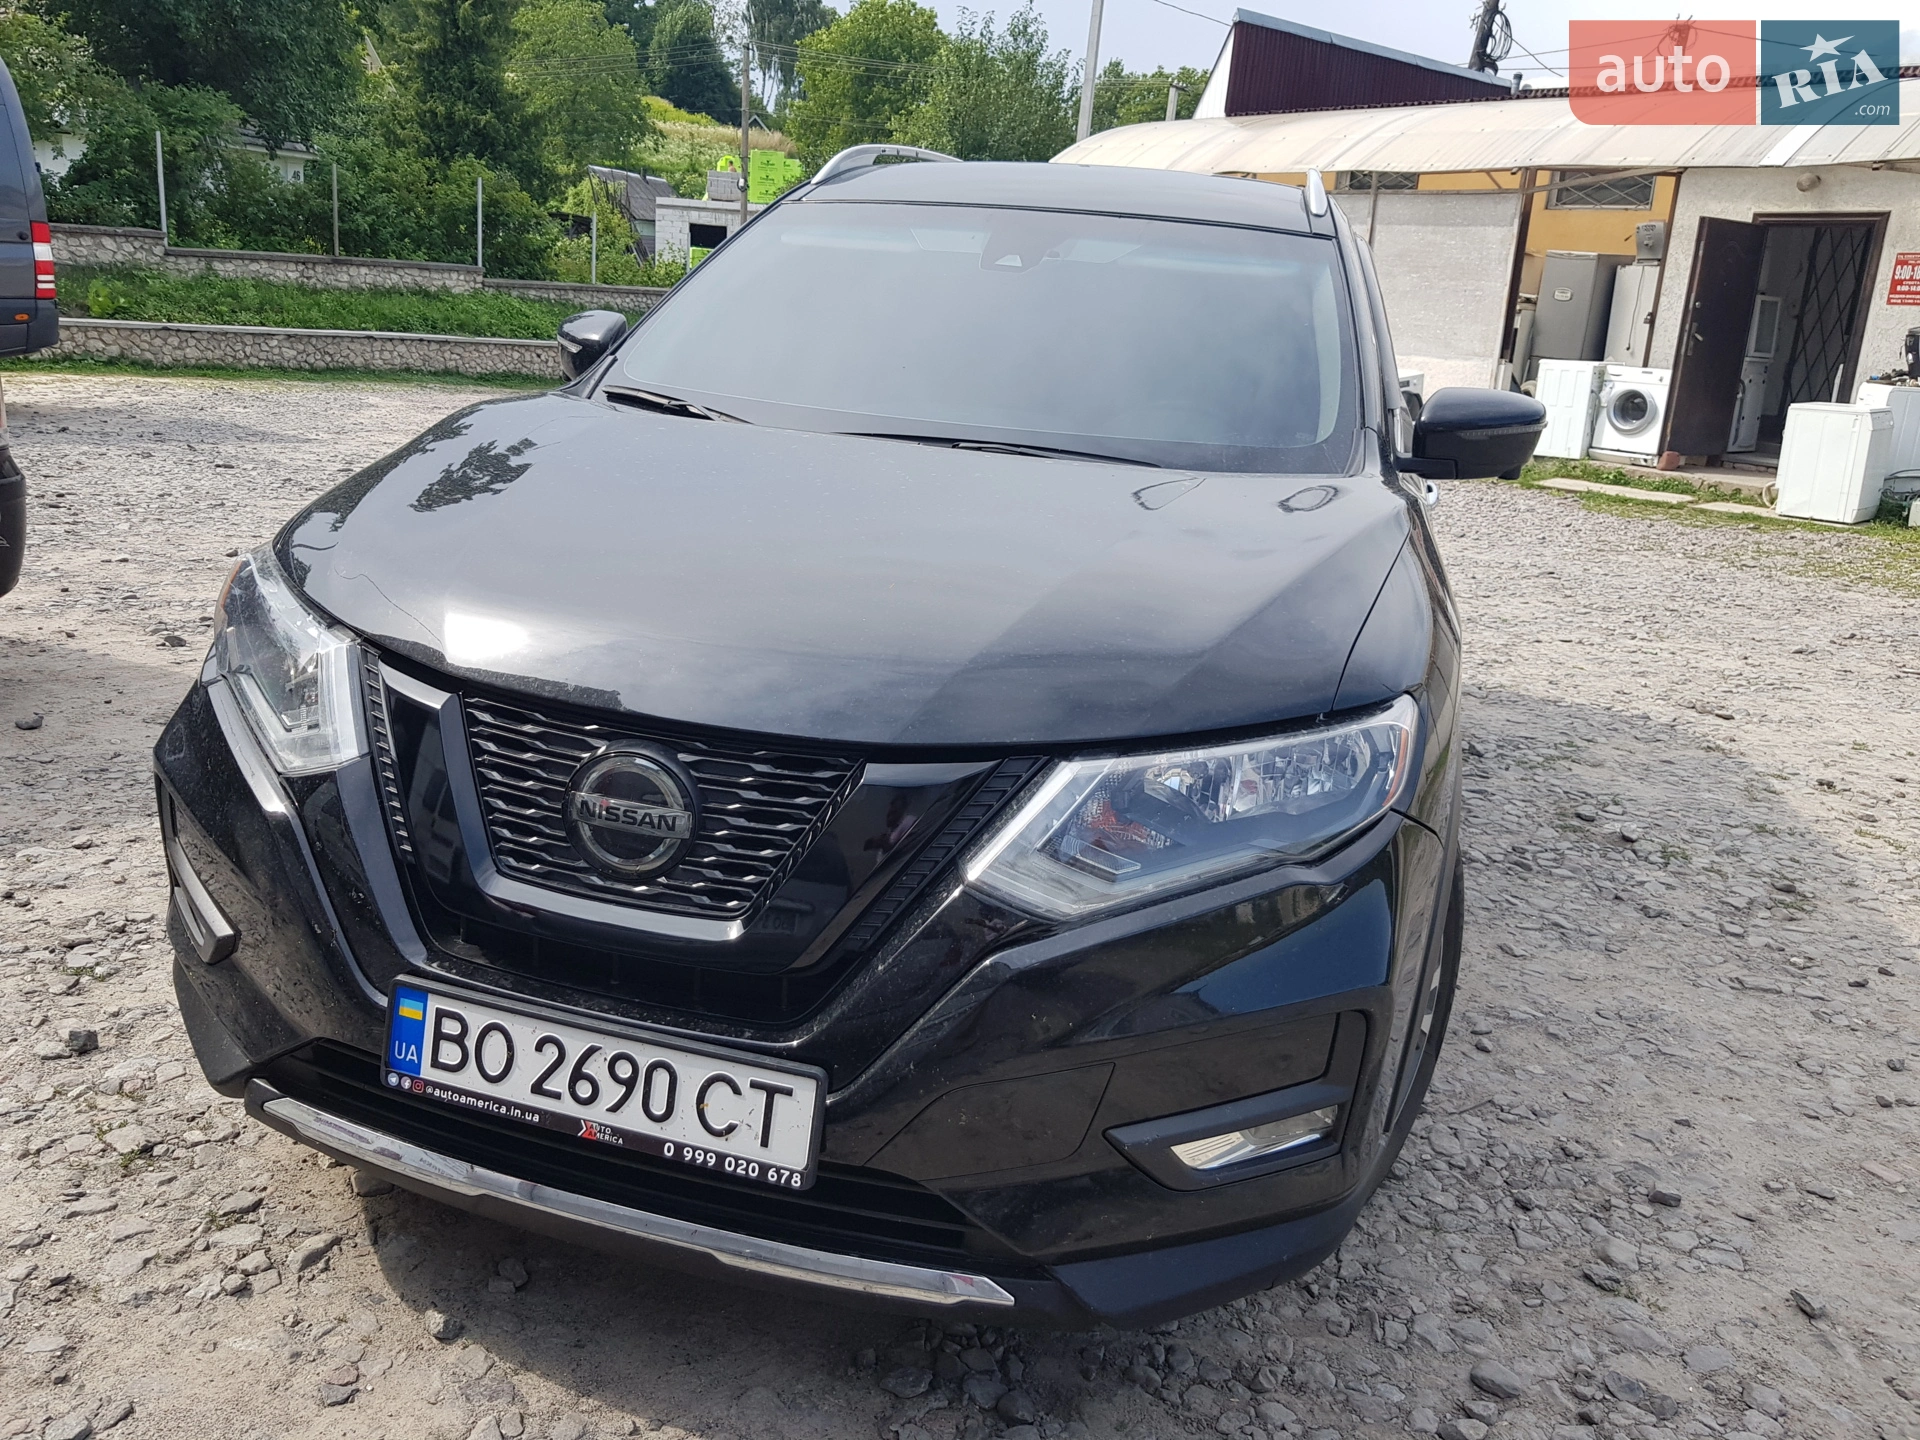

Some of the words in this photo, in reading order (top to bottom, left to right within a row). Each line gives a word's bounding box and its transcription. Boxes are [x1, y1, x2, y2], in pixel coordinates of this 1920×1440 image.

[579, 800, 677, 832] NISSAN
[394, 1040, 418, 1064] UA
[430, 1006, 515, 1084] BO
[530, 1033, 678, 1123] 2690
[695, 1071, 794, 1148] CT
[425, 1085, 540, 1122] @autoamerica.in.ua
[663, 1142, 675, 1157] 0
[683, 1147, 716, 1167] 999
[724, 1157, 759, 1177] 020
[767, 1167, 801, 1187] 678
